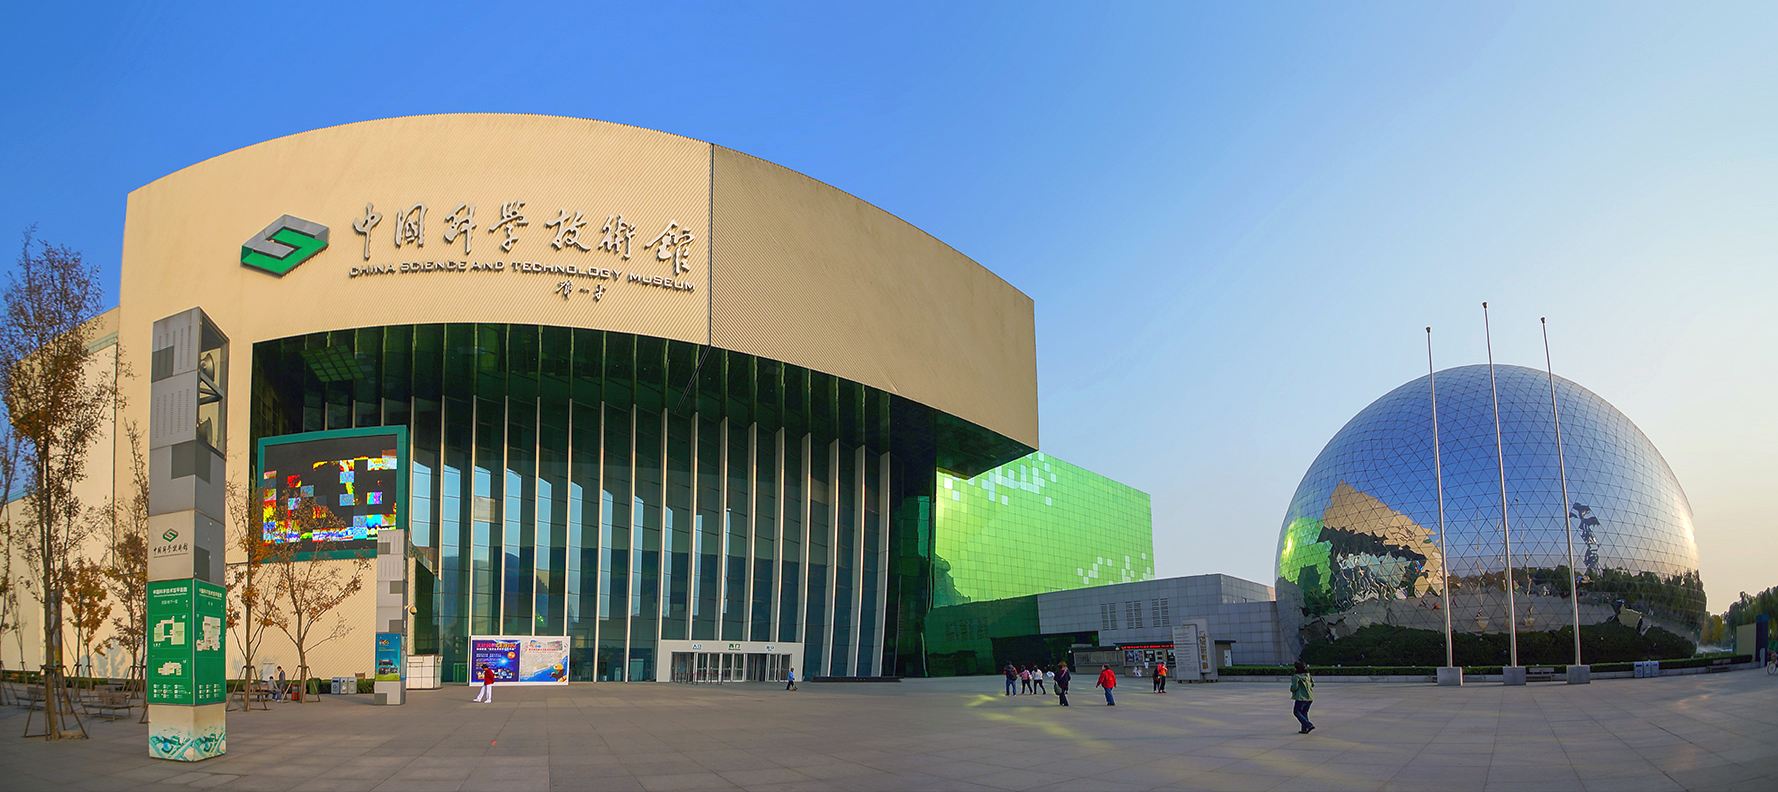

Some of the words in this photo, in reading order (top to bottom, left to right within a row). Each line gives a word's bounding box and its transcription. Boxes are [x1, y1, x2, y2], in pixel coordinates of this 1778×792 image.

[349, 264, 396, 278] CHINA
[400, 261, 467, 273] SCIENCE
[470, 261, 505, 273] AND
[512, 261, 622, 281] TECHNOLOGY
[627, 271, 696, 293] MUSEUM
